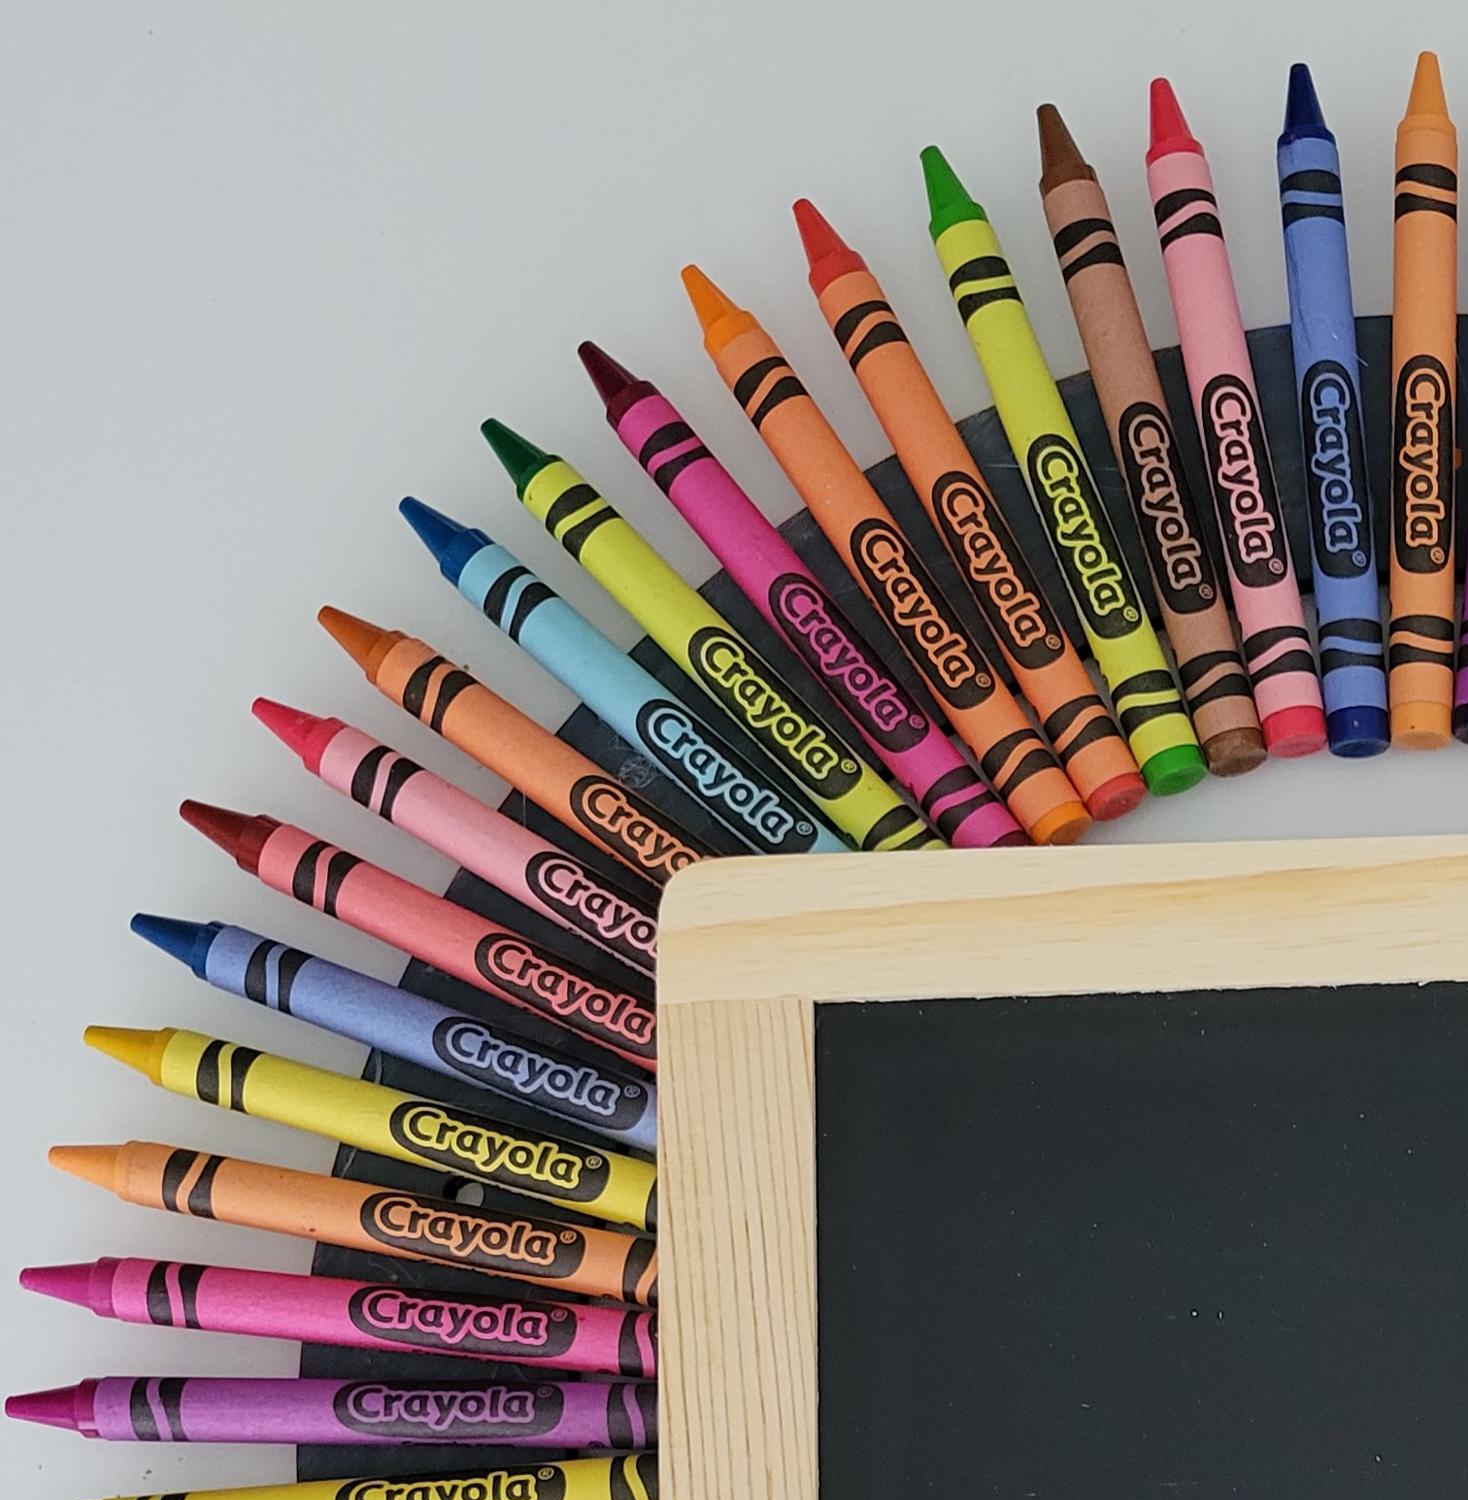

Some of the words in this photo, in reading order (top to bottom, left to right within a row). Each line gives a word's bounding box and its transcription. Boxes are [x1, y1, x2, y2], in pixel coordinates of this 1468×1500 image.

[1129, 412, 1201, 591] Crayola
[1210, 386, 1275, 564] Crayola
[1310, 371, 1362, 554] Crayola
[1400, 366, 1446, 547] Crayola
[939, 480, 1048, 650] Crayola
[1035, 445, 1127, 618] Crayola
[779, 583, 910, 730] Crayola
[859, 527, 978, 688] Crayola
[648, 707, 793, 839] Crayola
[699, 632, 839, 779] Crayola
[582, 783, 703, 875] Crayo
[538, 858, 658, 957] Crayo
[488, 938, 657, 1046] Crayola
[445, 1024, 622, 1116] Crayola
[403, 1109, 583, 1190] Crayola
[375, 1200, 556, 1267] Crayola
[362, 1290, 549, 1345] Crayola
[347, 1385, 535, 1430] Crayola
